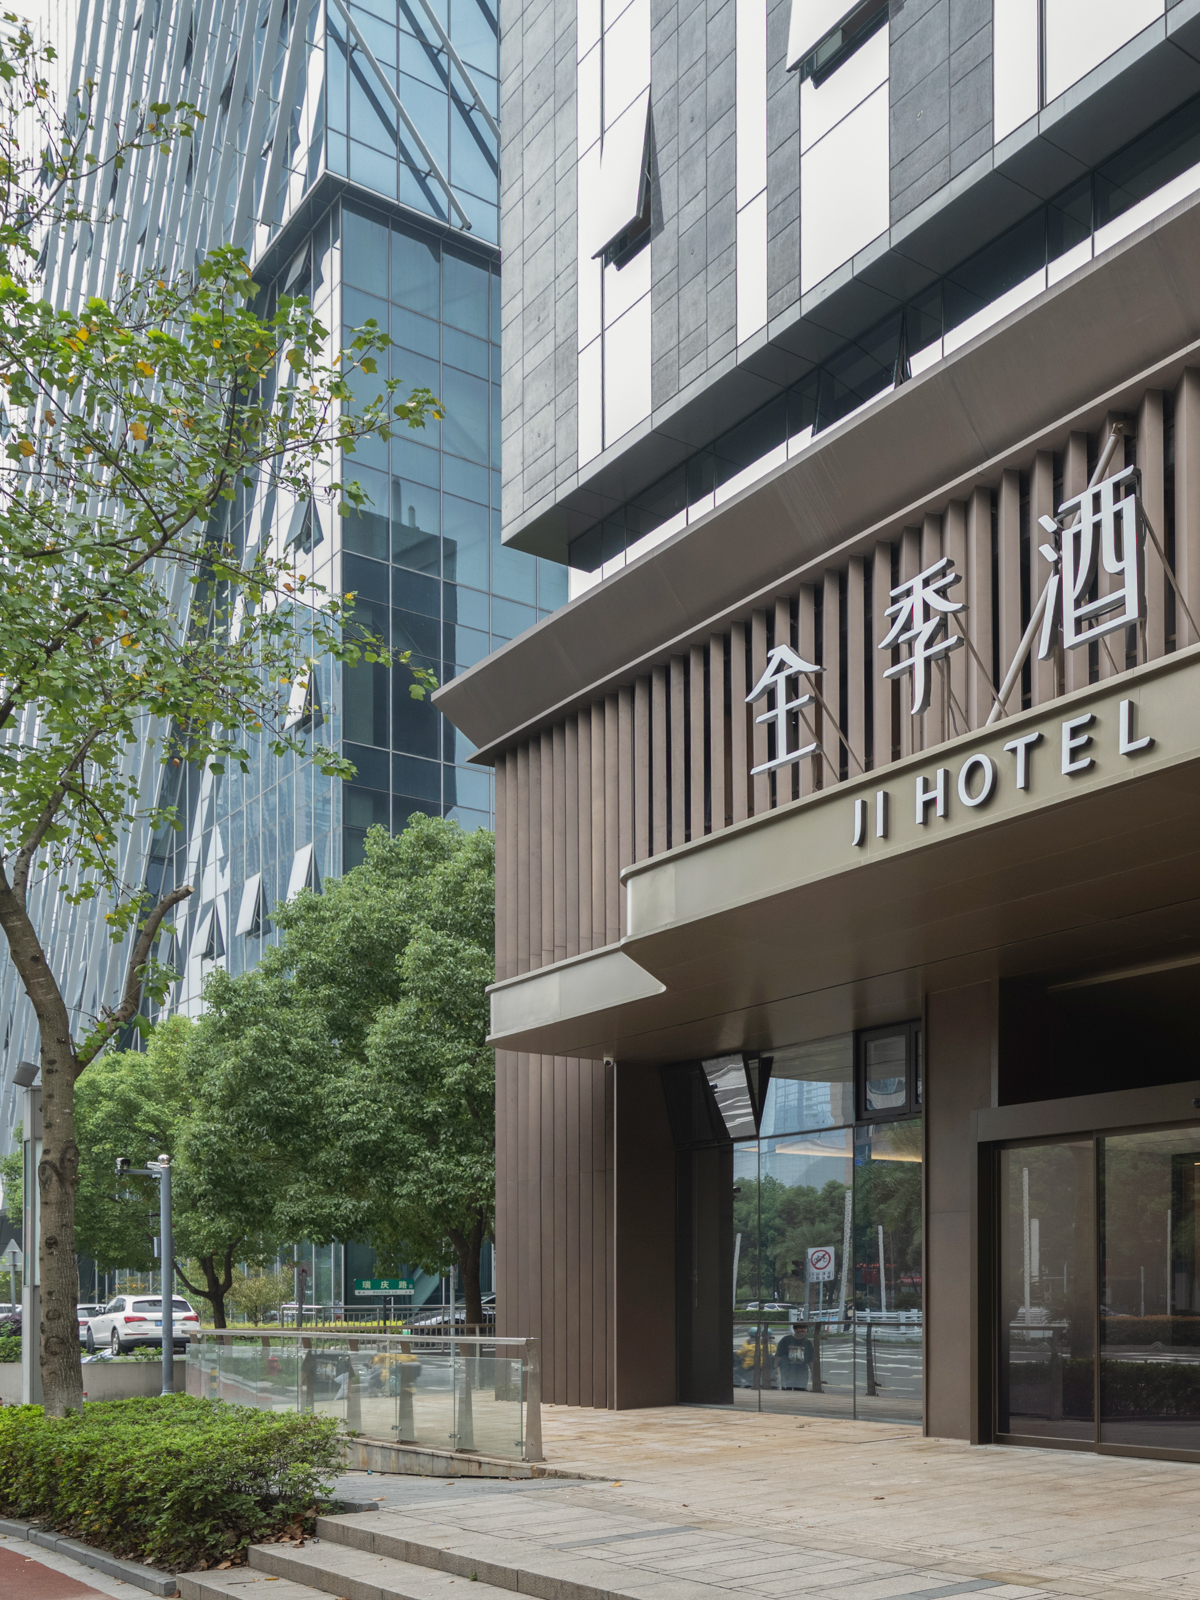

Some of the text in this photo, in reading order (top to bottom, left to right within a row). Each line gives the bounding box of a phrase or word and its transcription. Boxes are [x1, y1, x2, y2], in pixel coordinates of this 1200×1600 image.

[852, 699, 1156, 847] JI HOTEL
[361, 1280, 408, 1289] 瑞庆路
